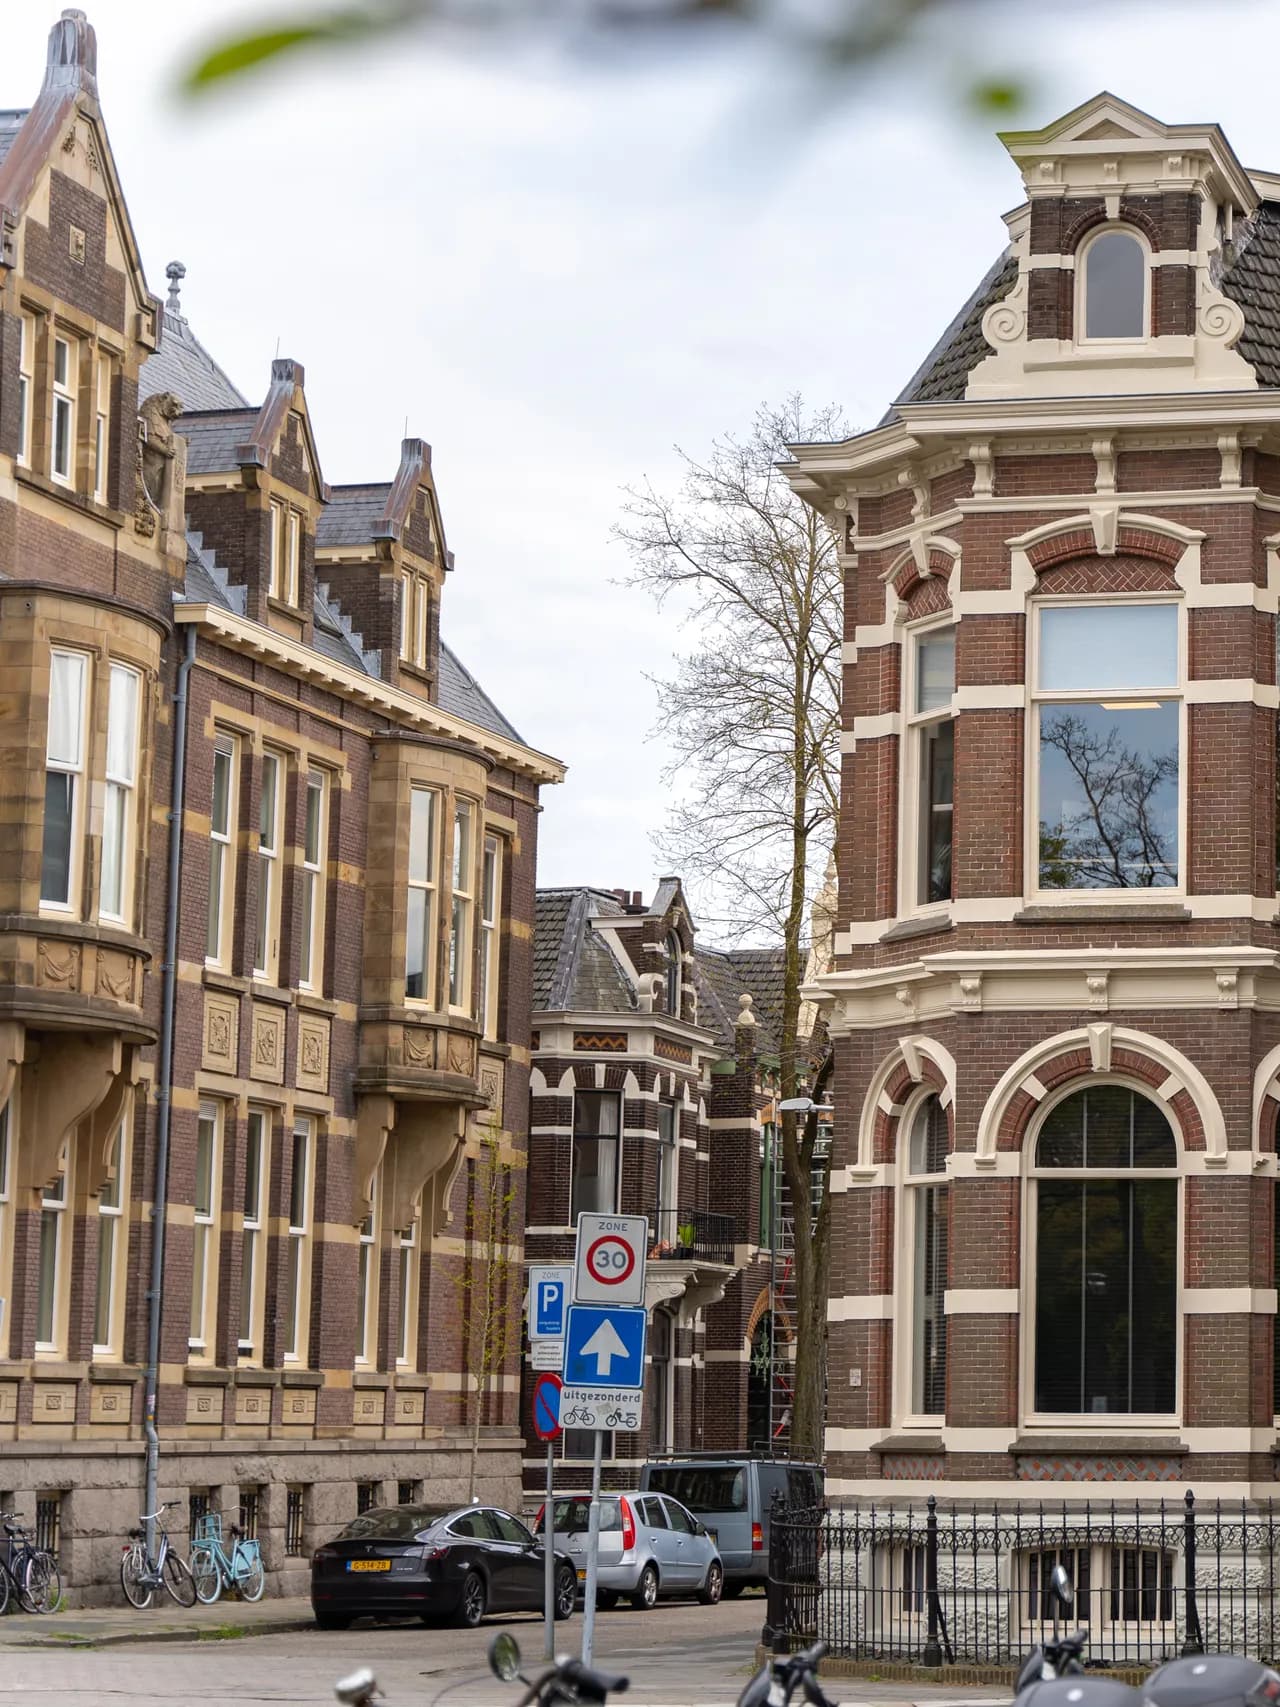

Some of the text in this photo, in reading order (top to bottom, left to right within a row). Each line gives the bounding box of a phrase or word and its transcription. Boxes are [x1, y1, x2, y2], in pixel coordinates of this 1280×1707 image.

[598, 1221, 629, 1232] ZONE
[596, 1250, 627, 1269] 30
[542, 1271, 561, 1279] ZONE
[543, 1284, 559, 1313] P
[563, 1390, 641, 1403] uitgezonderd
